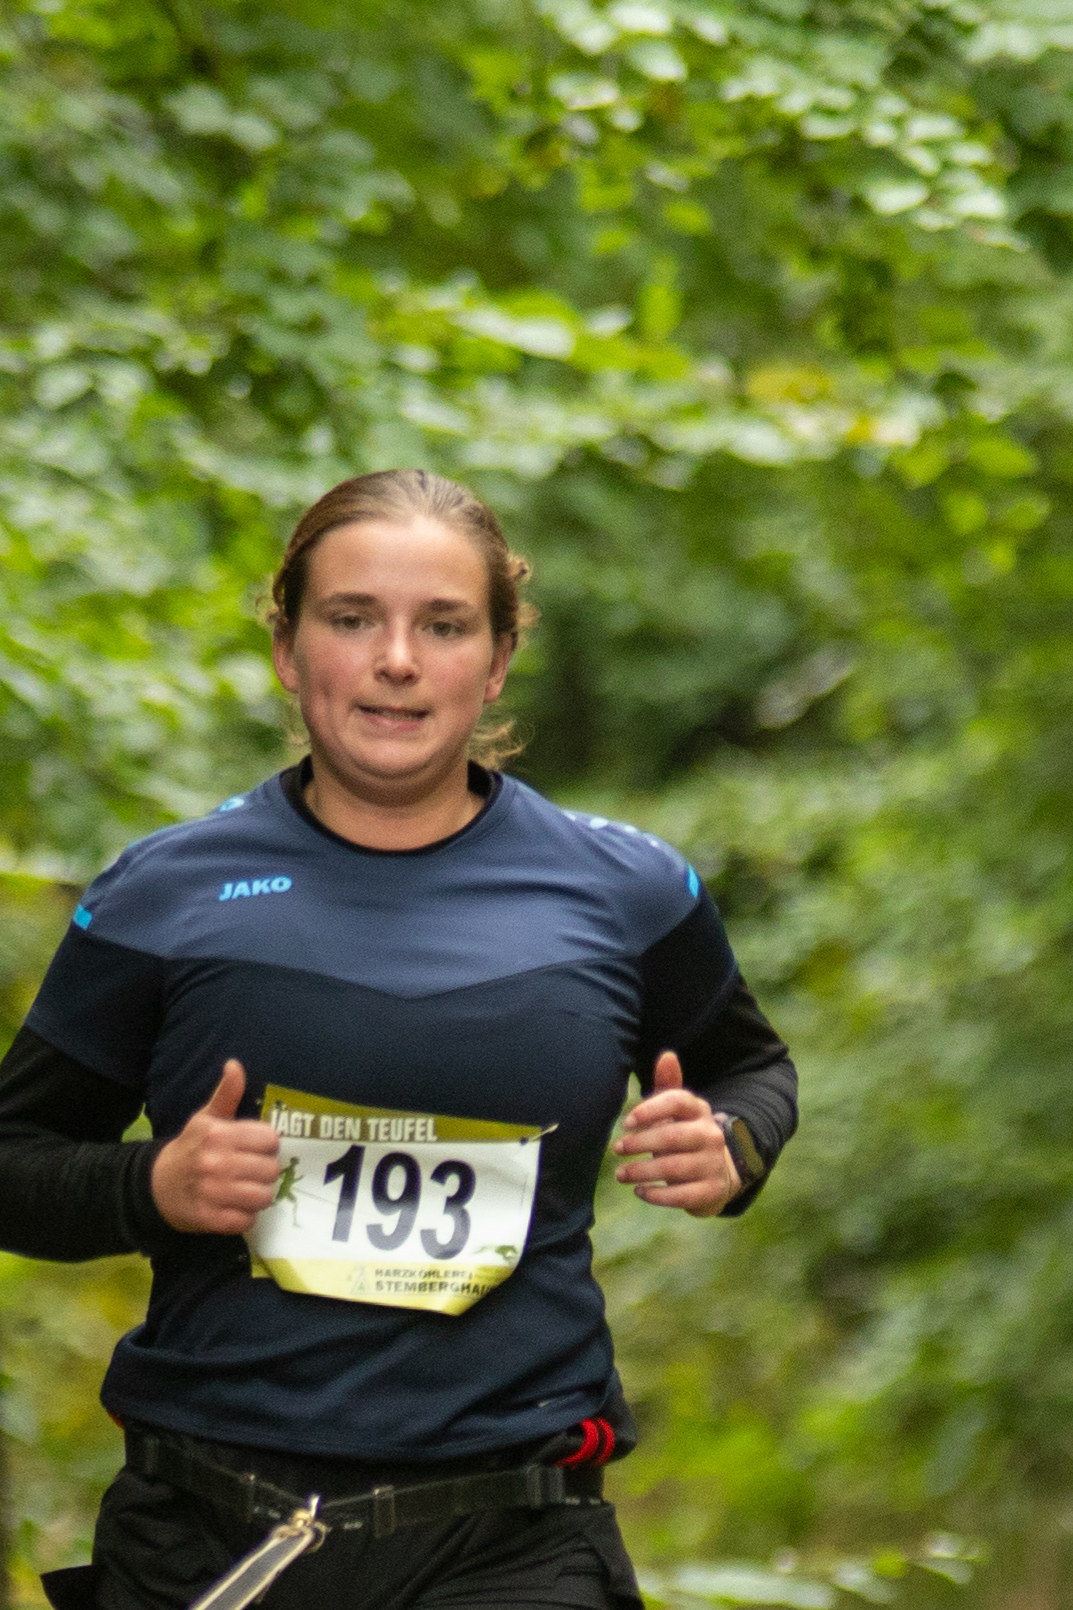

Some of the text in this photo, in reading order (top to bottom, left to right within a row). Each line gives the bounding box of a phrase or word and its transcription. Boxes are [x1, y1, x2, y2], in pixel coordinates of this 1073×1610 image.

[218, 875, 292, 902] JAKO
[319, 1114, 361, 1141] DEN
[367, 1116, 438, 1142] TEUFEL
[323, 1144, 476, 1260] 193
